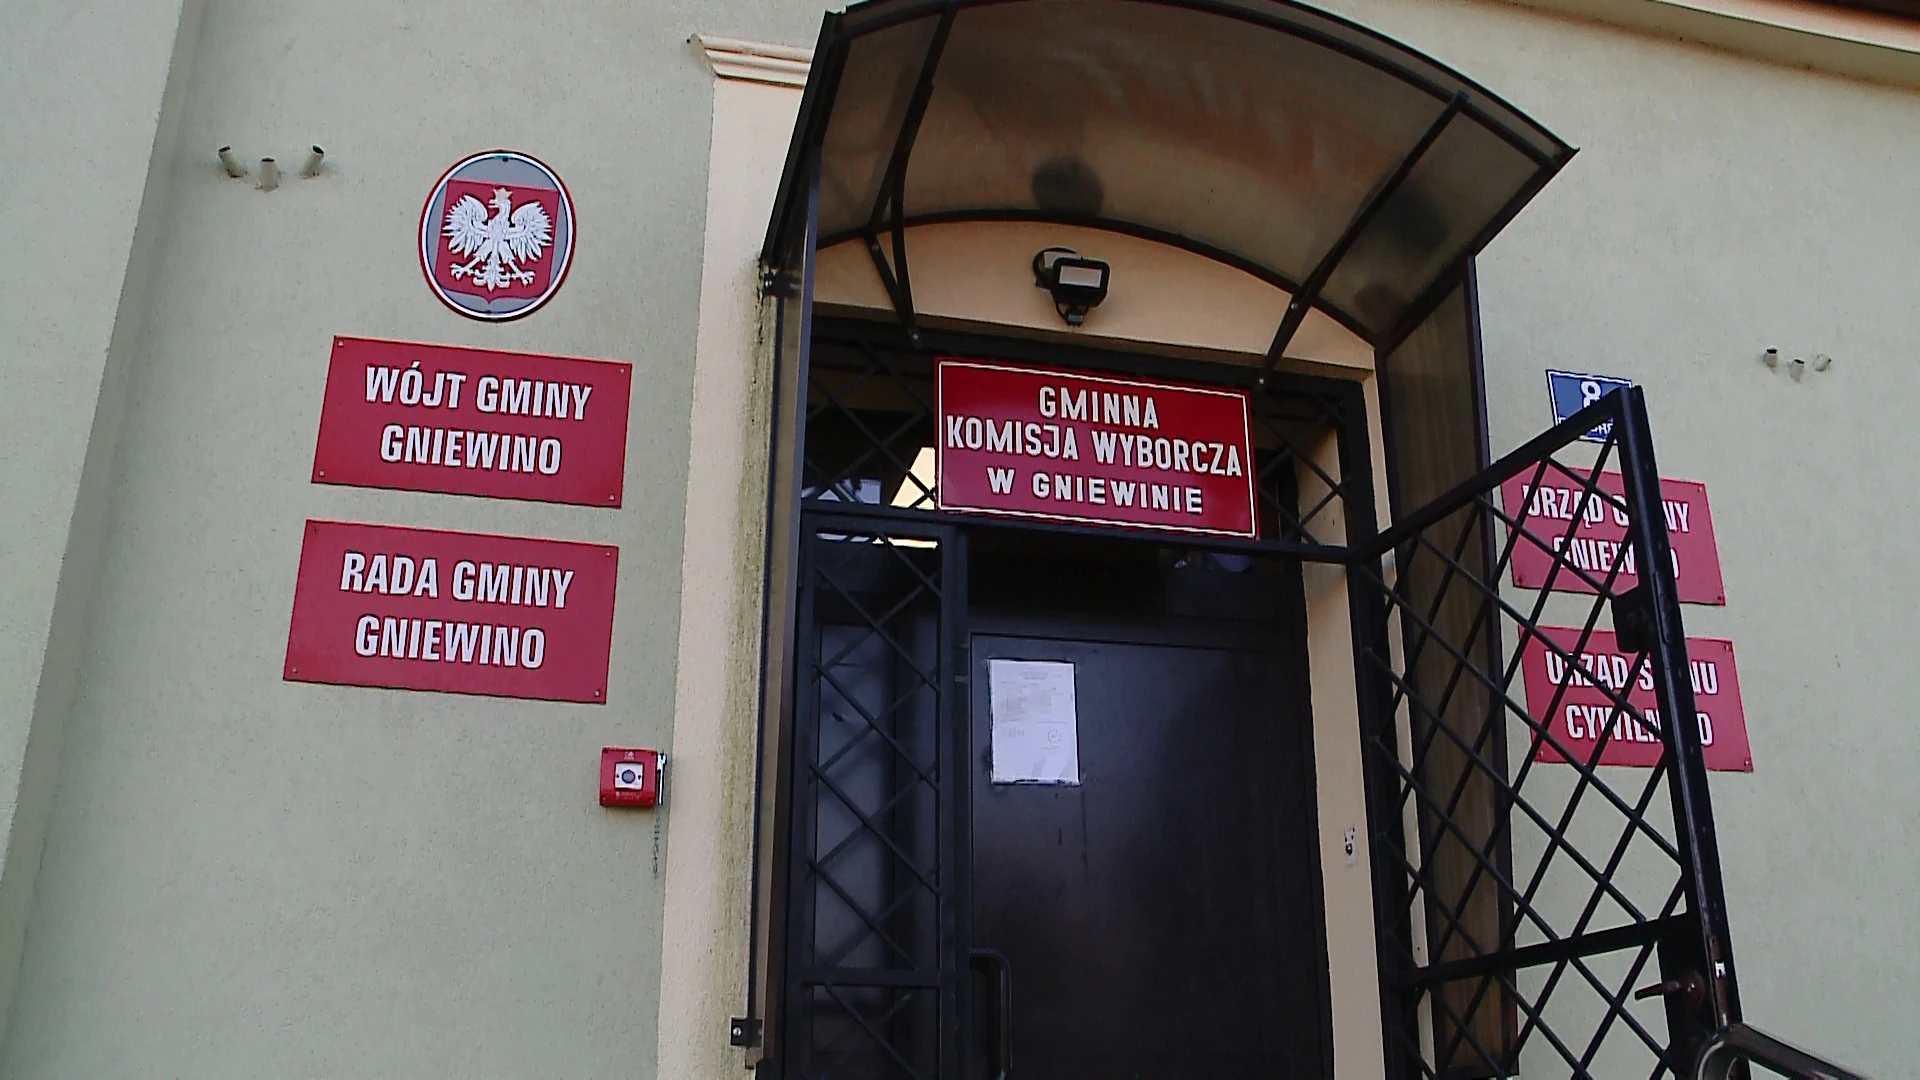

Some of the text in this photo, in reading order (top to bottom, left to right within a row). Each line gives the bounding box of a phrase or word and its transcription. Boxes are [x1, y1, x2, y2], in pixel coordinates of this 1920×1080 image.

[365, 361, 592, 421] WÓJT GMINY
[1039, 386, 1160, 430] GMINNA
[380, 423, 562, 475] GNIEWINO
[946, 415, 1243, 477] KOMISJA WYBORCZA
[986, 466, 1204, 514] W GNIEWINIE
[1611, 492, 1690, 533] GNY
[339, 551, 575, 609] RADA GMINY
[355, 614, 546, 670] GNIEWINO
[1638, 657, 1718, 695] SNU
[1565, 704, 1714, 746] CYWILNO
